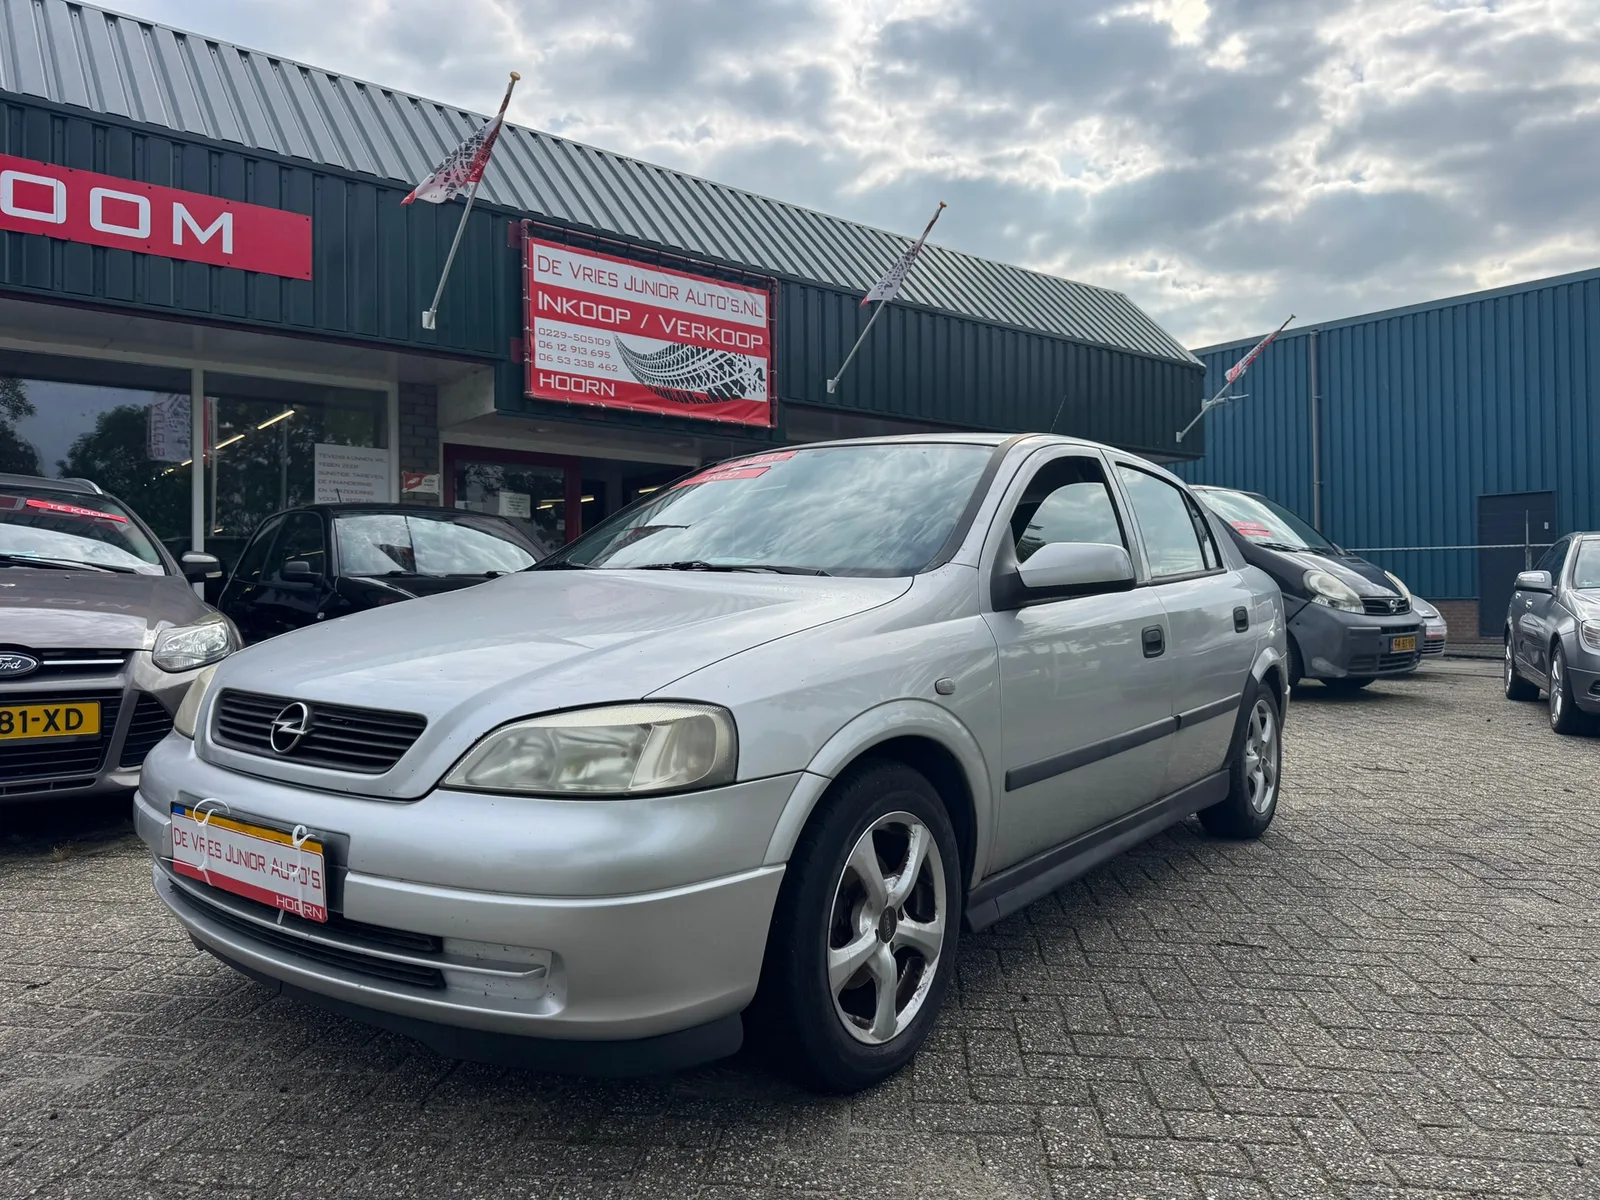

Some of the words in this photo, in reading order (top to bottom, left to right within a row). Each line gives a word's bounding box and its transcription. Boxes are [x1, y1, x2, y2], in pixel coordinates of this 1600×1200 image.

[0, 170, 233, 254] OOM
[538, 254, 562, 276] DE
[569, 261, 618, 288] VRIES
[624, 275, 679, 301] JUNIOR
[685, 288, 763, 318] AUTO'S.NL
[538, 290, 631, 324] INKOOP
[658, 314, 763, 349] VERKOOP
[538, 327, 611, 347] 0229-505109
[538, 340, 553, 349] 06
[557, 343, 567, 352] 12
[570, 345, 588, 356] 913
[590, 348, 611, 359] 695
[538, 353, 553, 362] 06
[557, 355, 571, 365] 53
[574, 358, 595, 369] 338
[598, 362, 618, 372] 462
[539, 372, 615, 397] HOORN
[48, 503, 66, 511] TE
[71, 508, 110, 518] KOOP
[174, 827, 188, 848] DE
[191, 832, 222, 859] VRES
[225, 845, 266, 874] JUNIOR
[276, 894, 323, 920] HOORN
